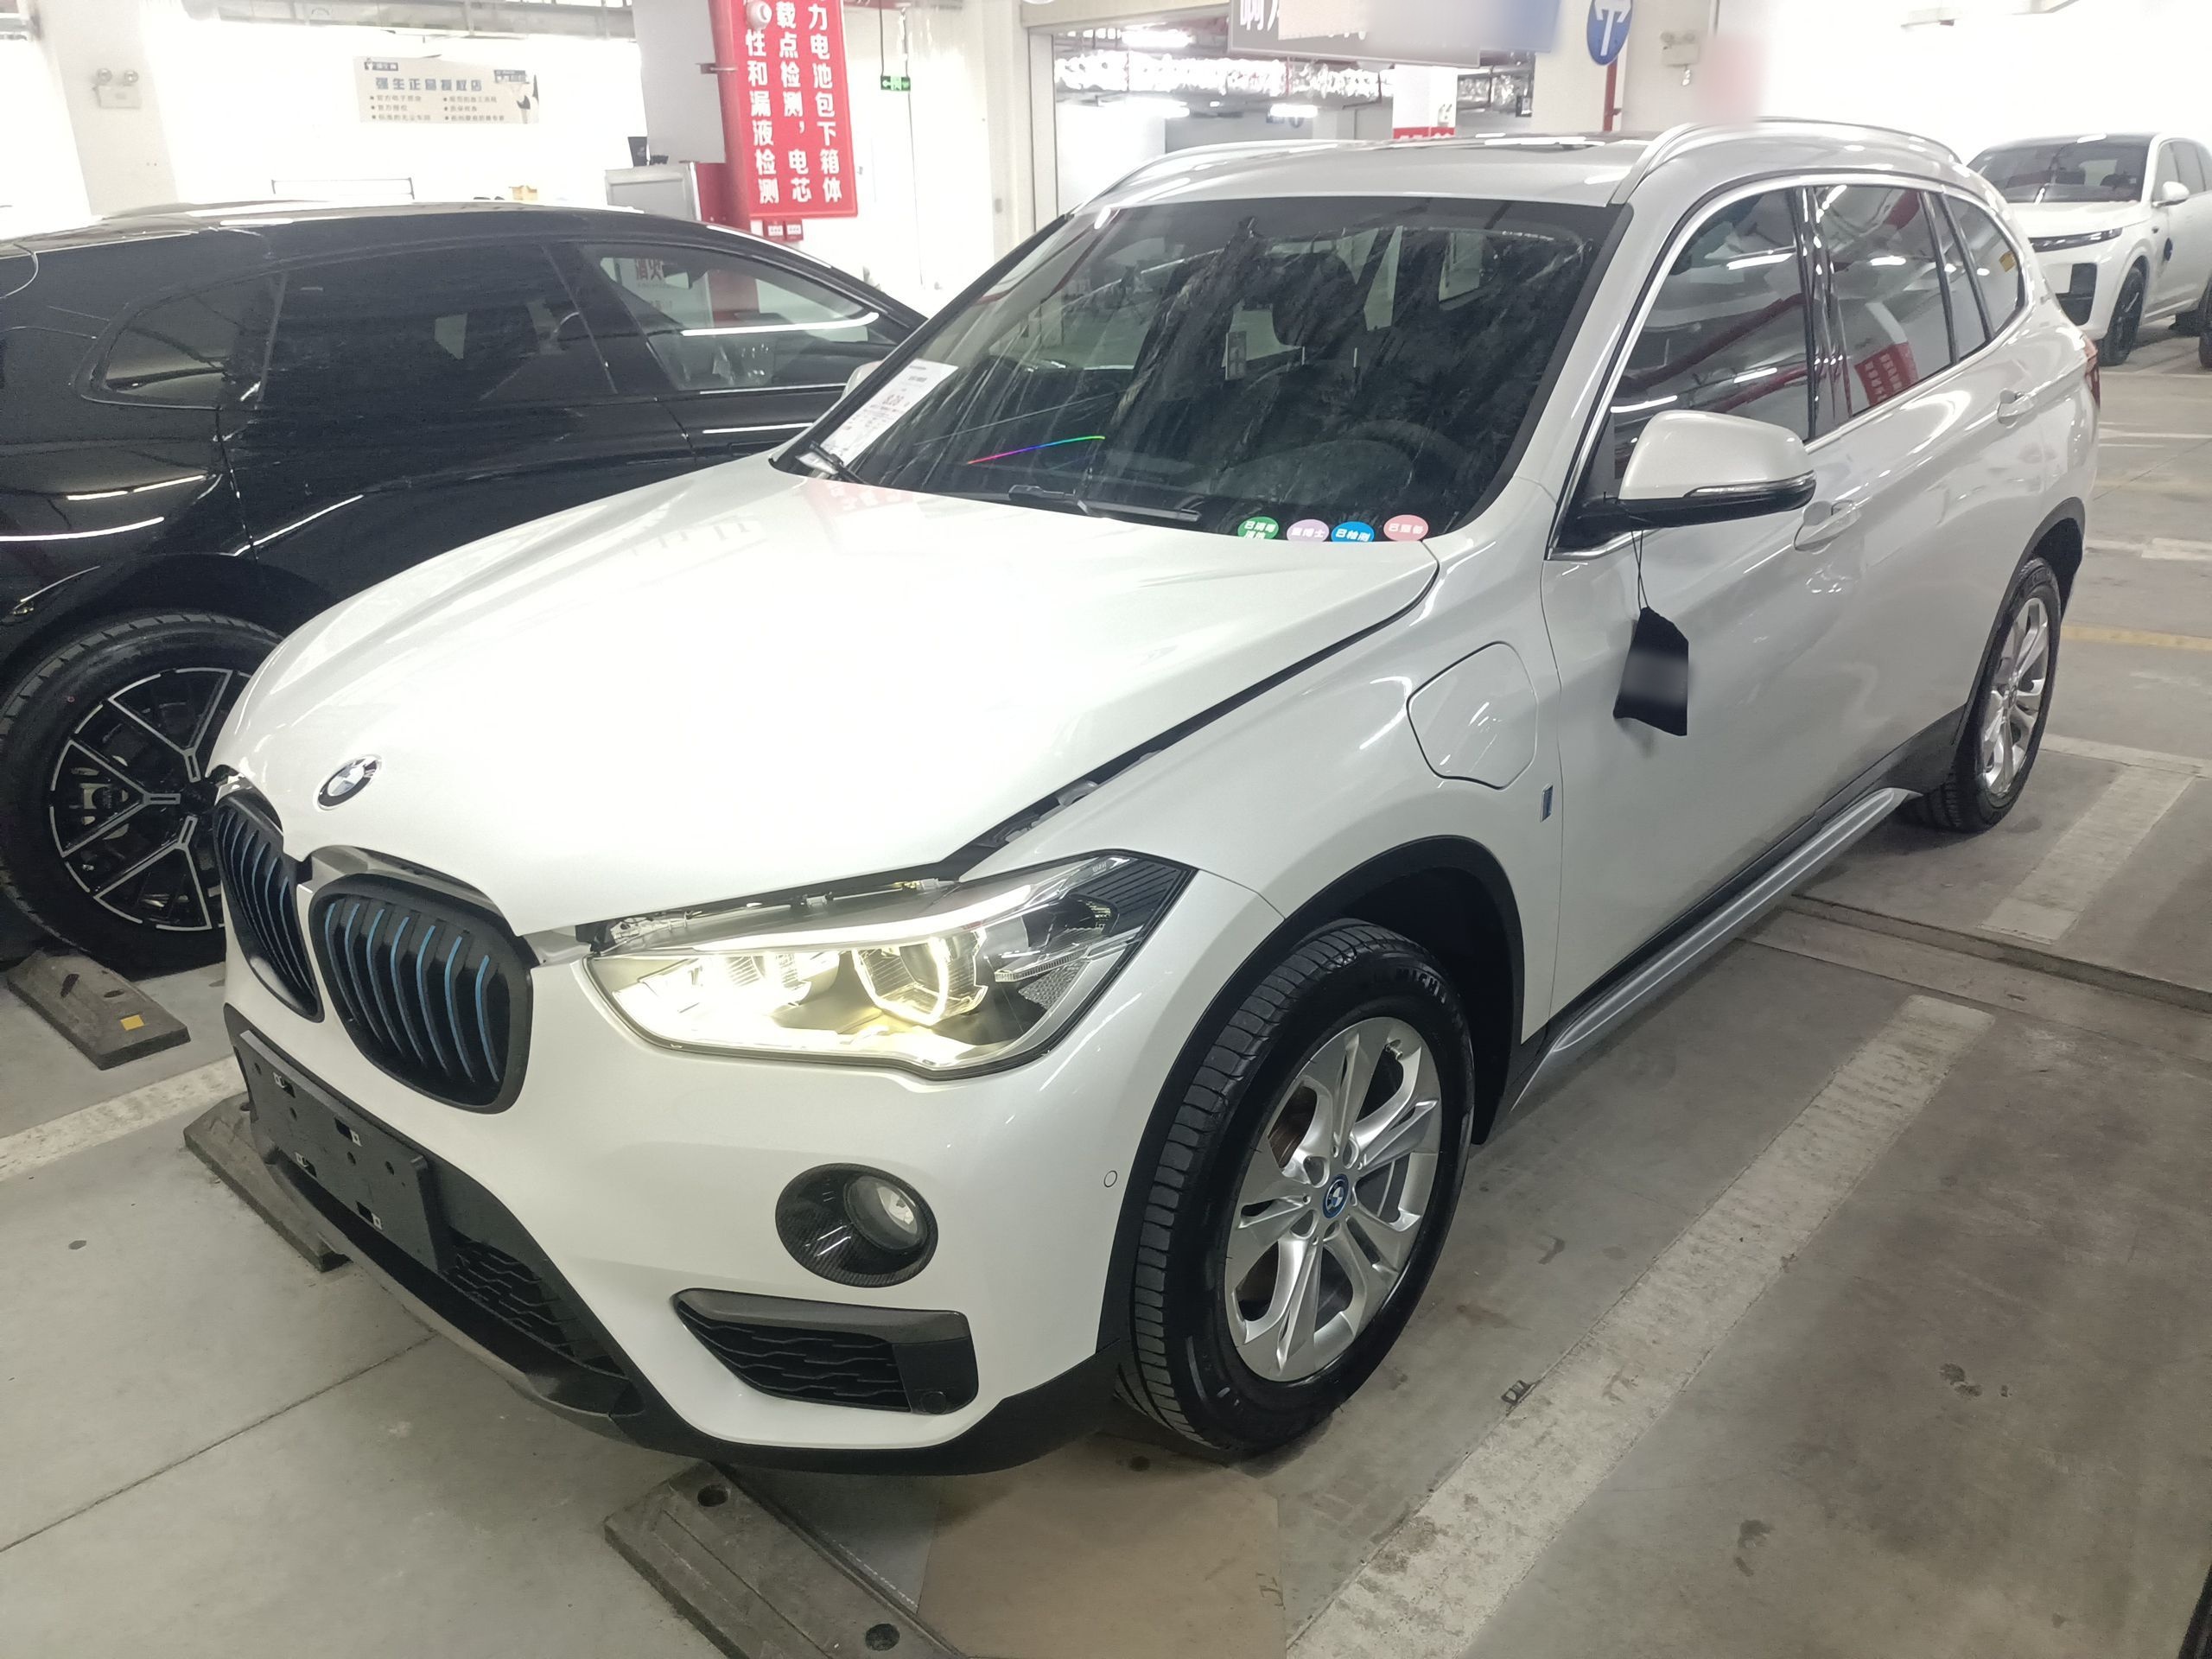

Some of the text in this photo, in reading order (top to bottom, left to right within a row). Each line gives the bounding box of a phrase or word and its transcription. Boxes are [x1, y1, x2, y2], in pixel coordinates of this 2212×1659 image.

[744, 0, 779, 204] 性和漏液检测
[808, 3, 842, 203] 力电池包下箱体
